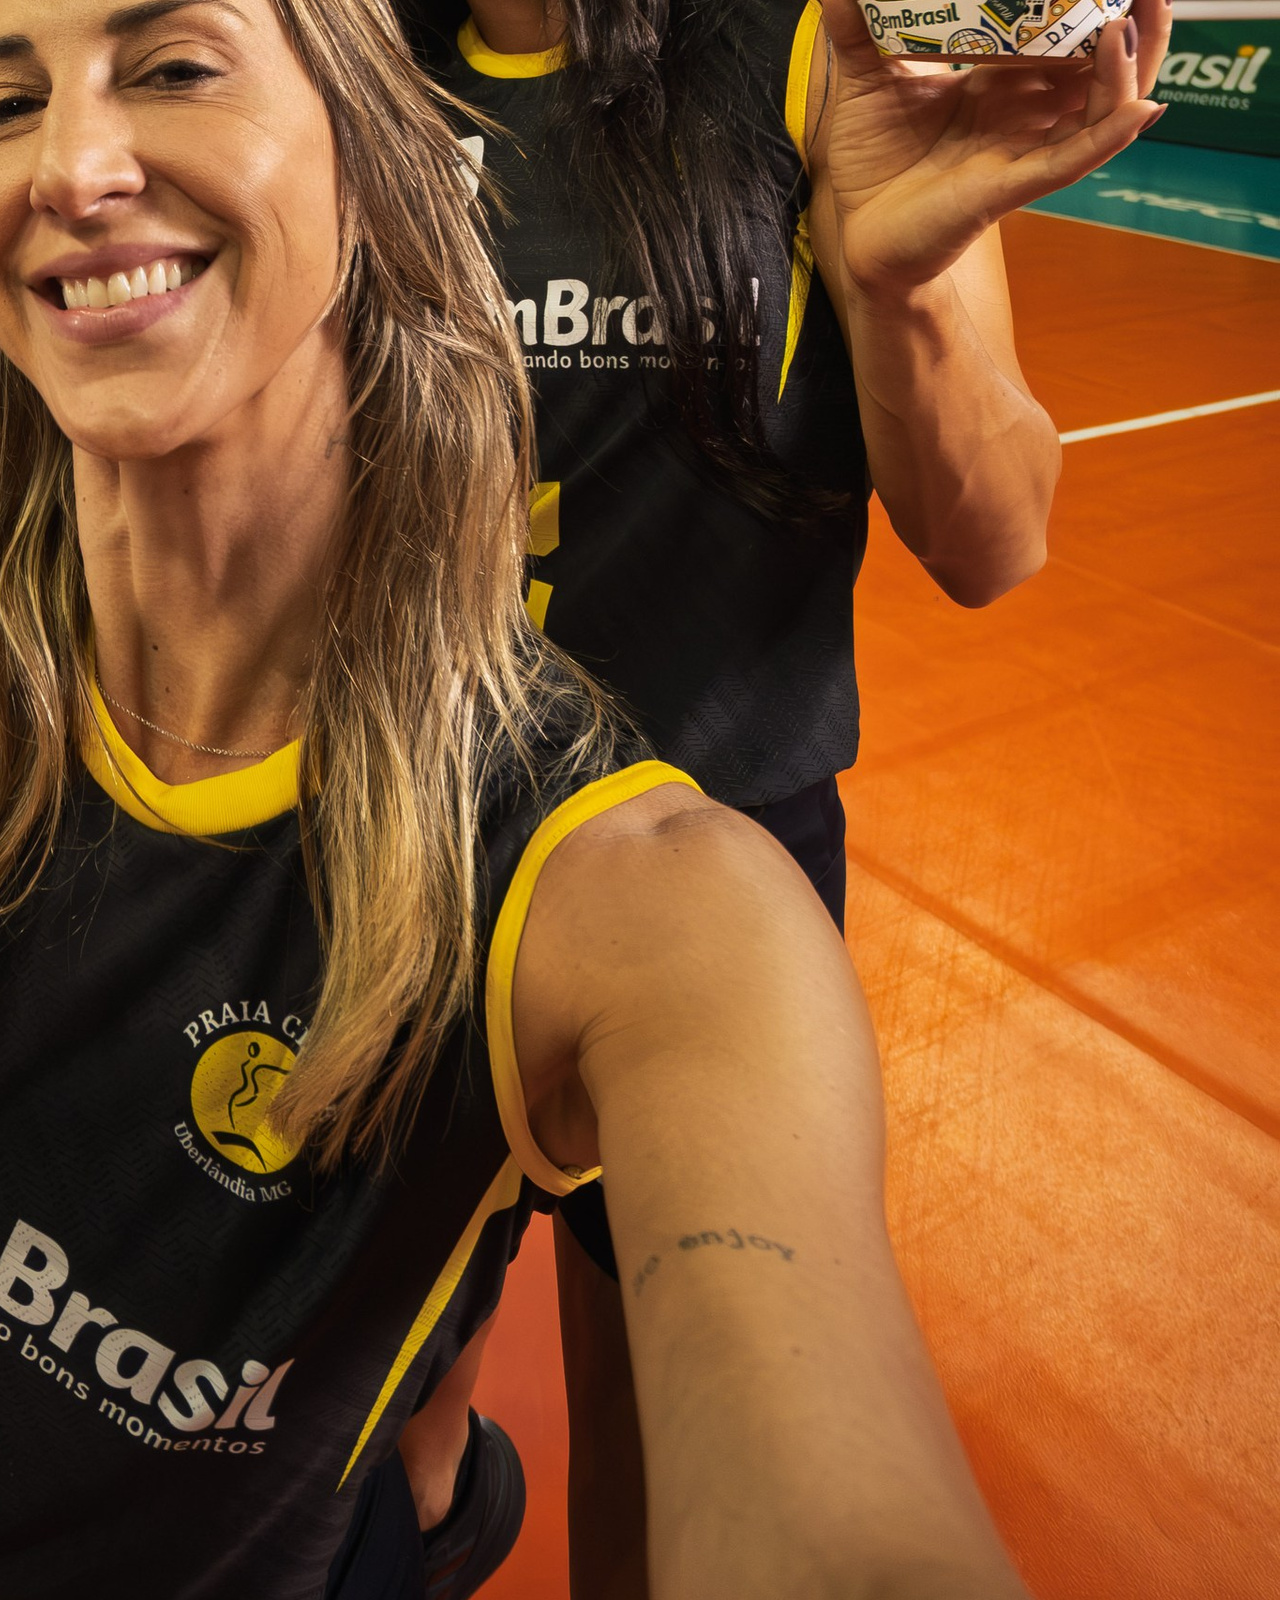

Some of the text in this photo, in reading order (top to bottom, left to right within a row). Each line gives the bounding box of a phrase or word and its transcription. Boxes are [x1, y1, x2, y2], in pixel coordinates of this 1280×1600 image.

[865, 2, 961, 40] BemBrasil
[1157, 87, 1250, 110] momentos
[579, 349, 630, 370] bons
[183, 1000, 272, 1048] PRAIA
[173, 1120, 293, 1203] Uberlândia MG
[20, 1334, 90, 1400] bons
[98, 1398, 267, 1455] momentos
